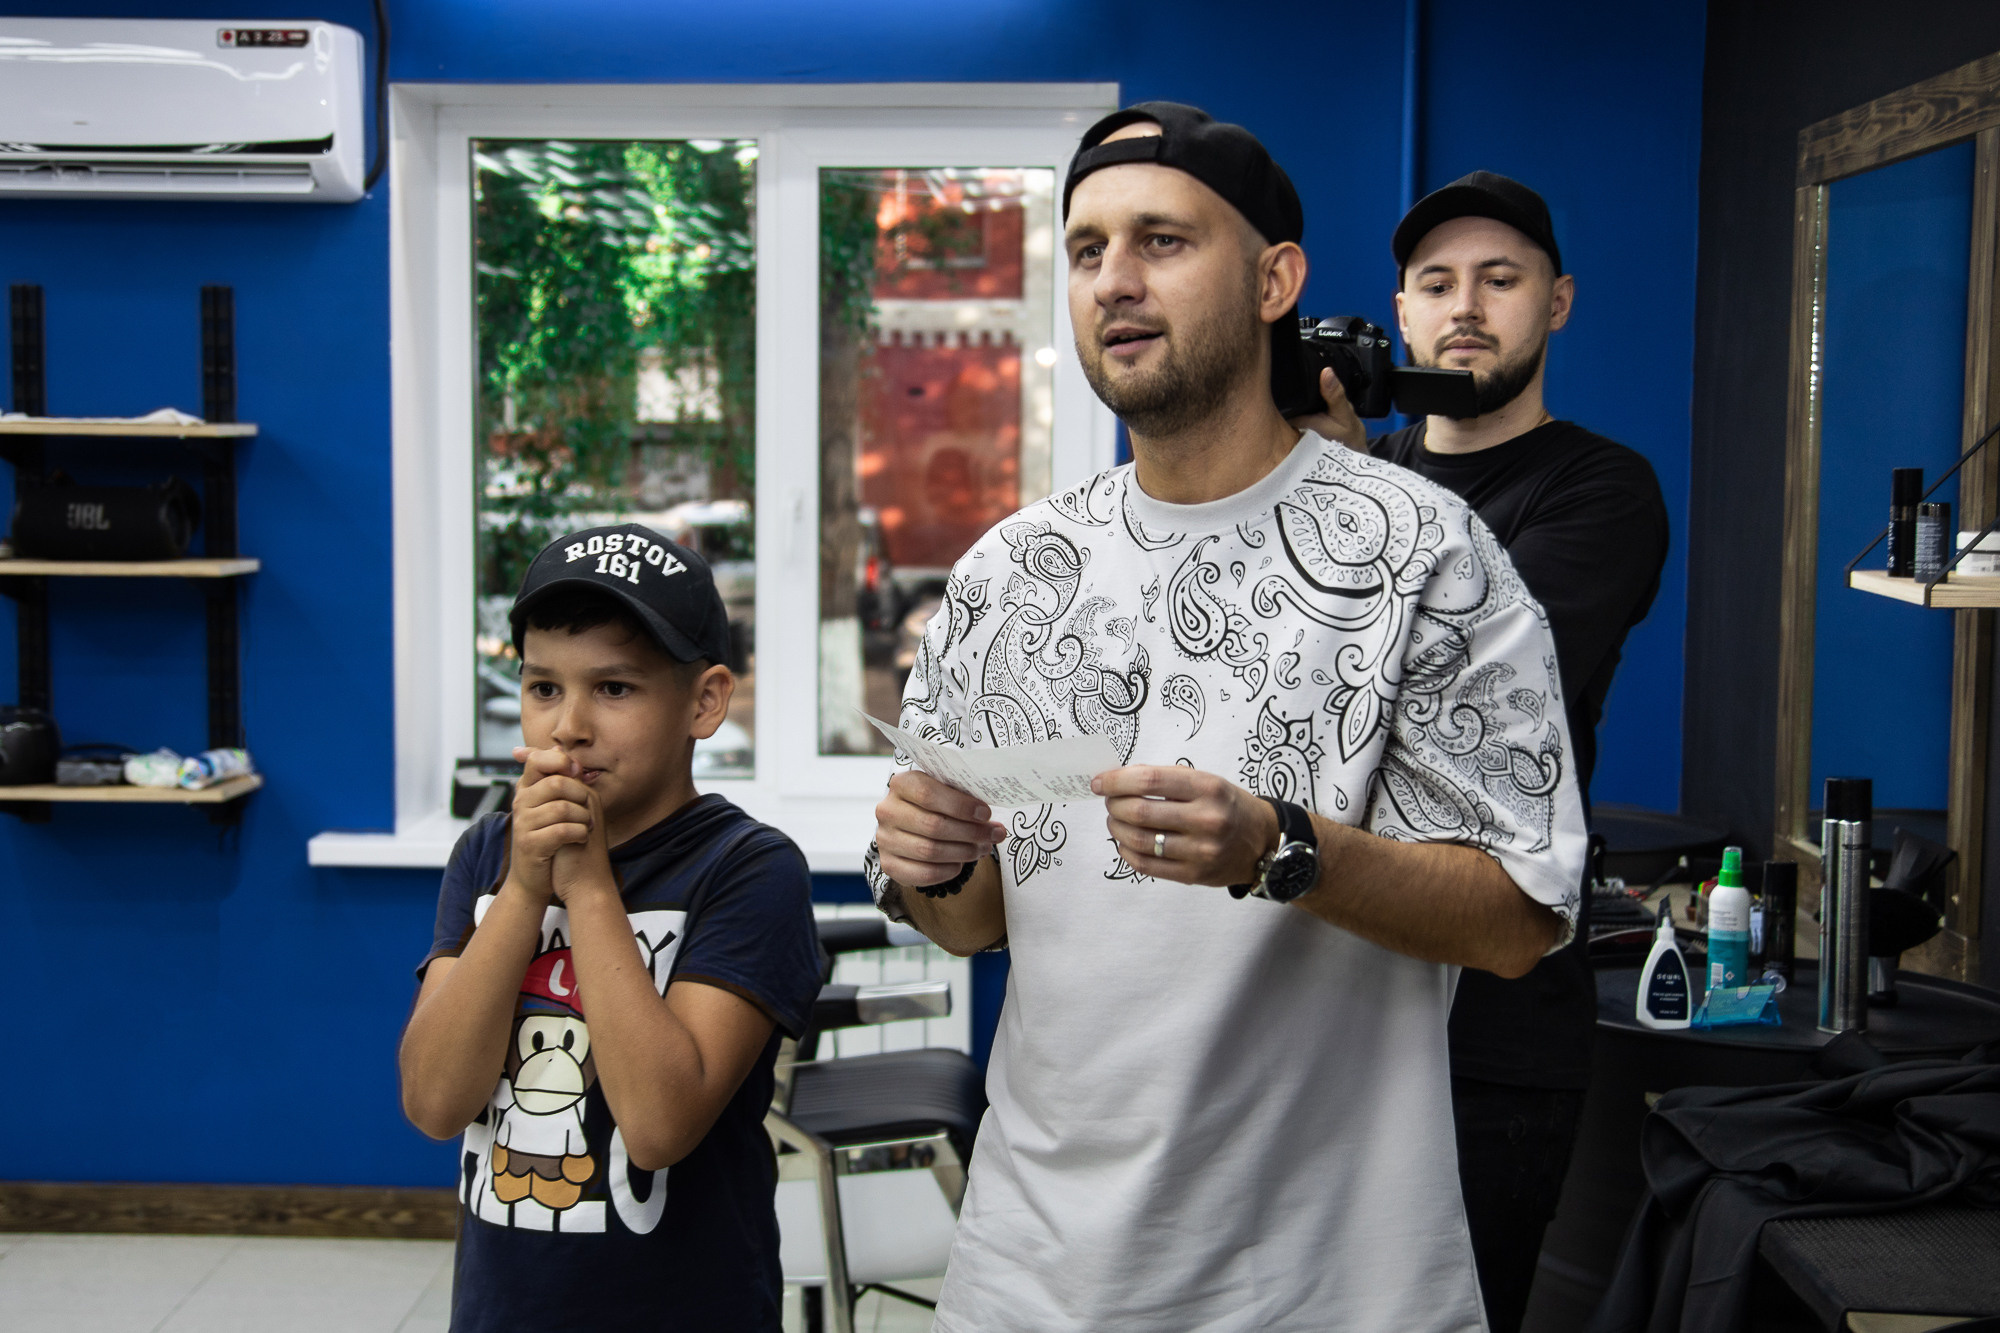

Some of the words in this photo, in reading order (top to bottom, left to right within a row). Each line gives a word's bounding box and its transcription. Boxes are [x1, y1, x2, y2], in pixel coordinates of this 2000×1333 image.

[66, 502, 112, 531] JBL
[564, 533, 688, 577] ROSTOV
[594, 553, 642, 585] 161
